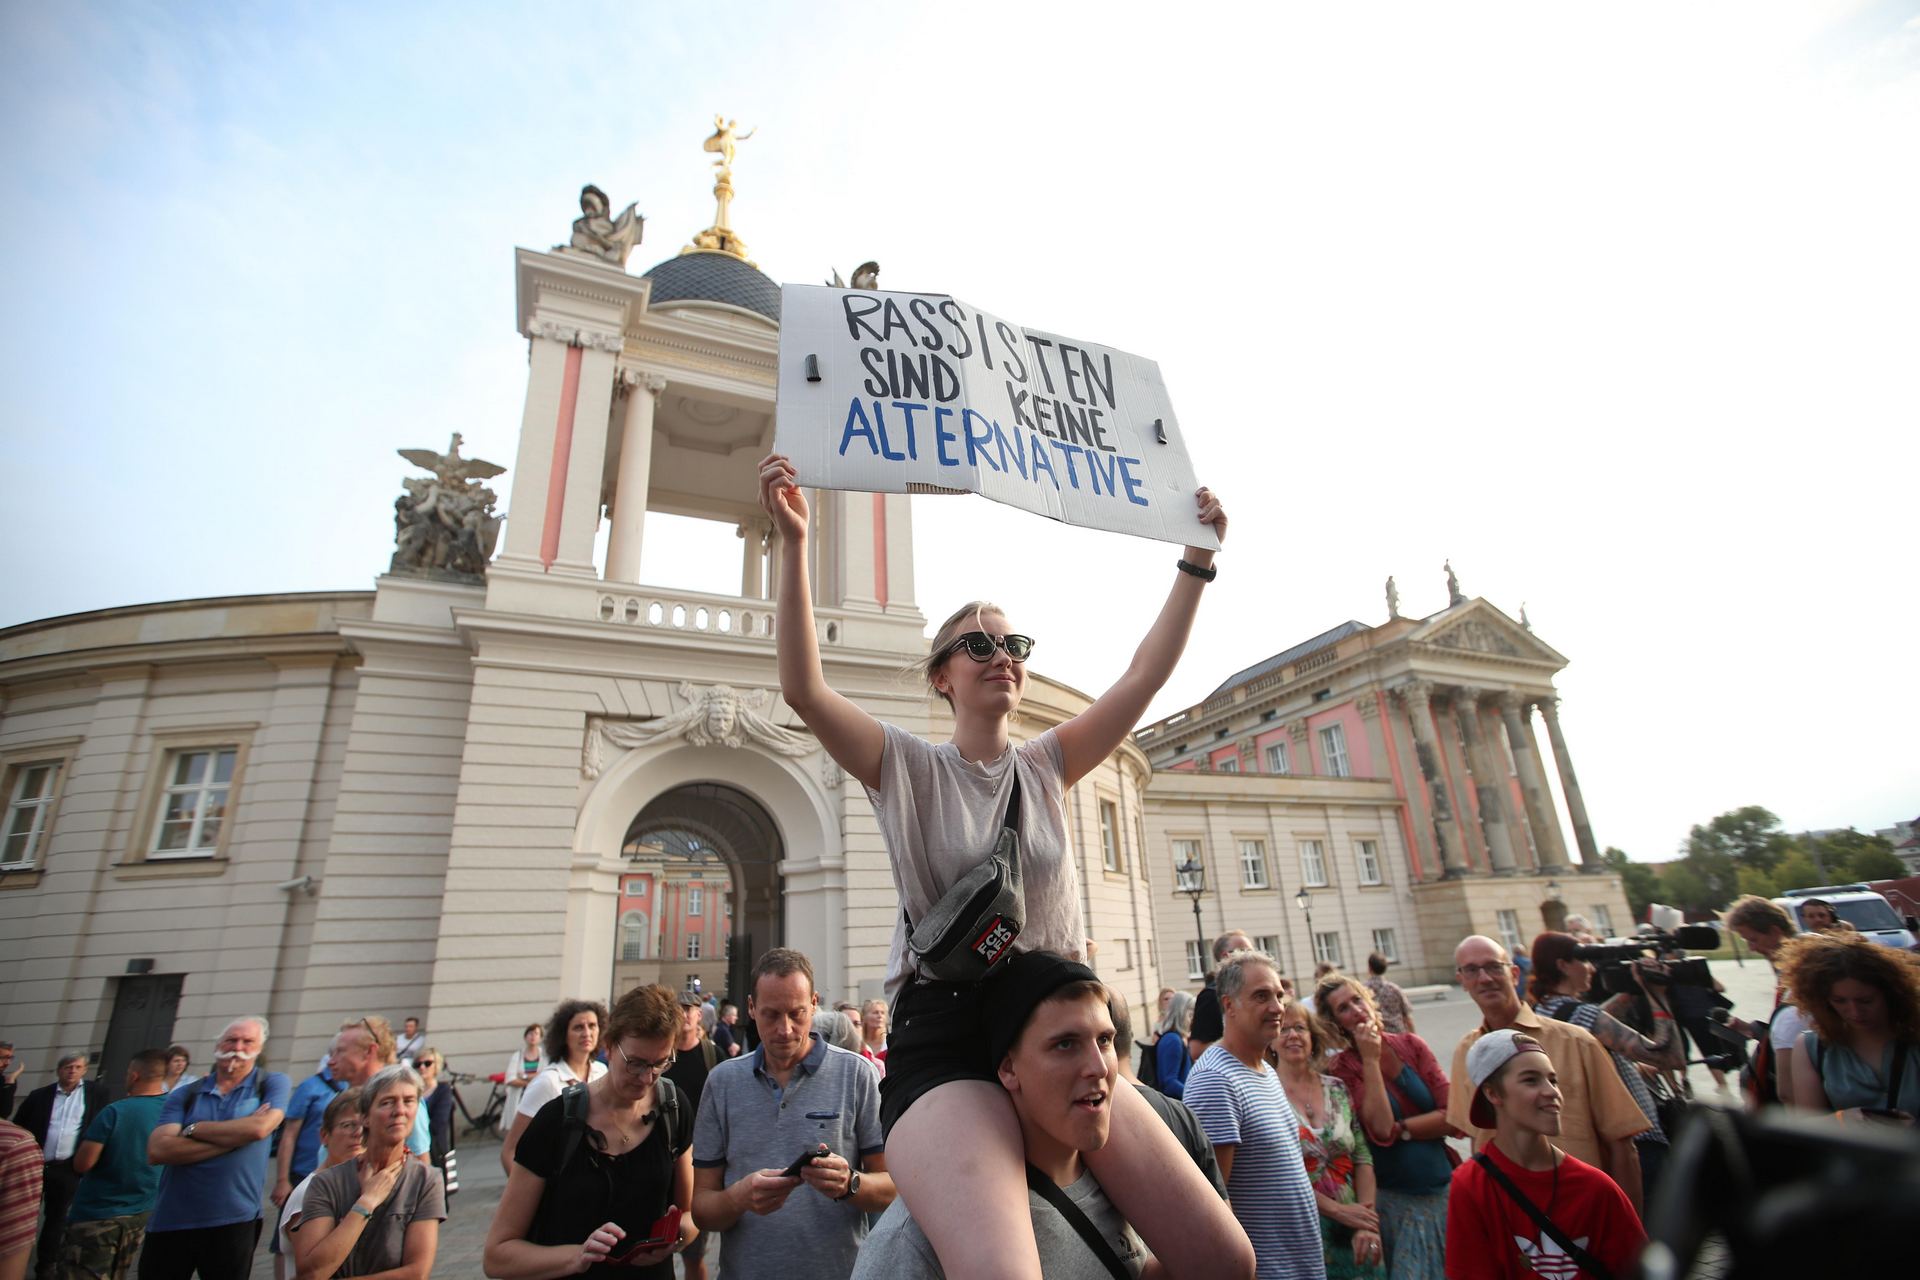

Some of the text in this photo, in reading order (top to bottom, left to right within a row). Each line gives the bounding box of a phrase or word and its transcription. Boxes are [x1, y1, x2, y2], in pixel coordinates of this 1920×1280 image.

[843, 294, 1115, 410] RASSISTEN
[860, 347, 1117, 452] SIND KEINE
[839, 397, 1149, 507] ALTERNATIVE
[977, 923, 1007, 955] FCK
[986, 931, 1011, 960] AFD
